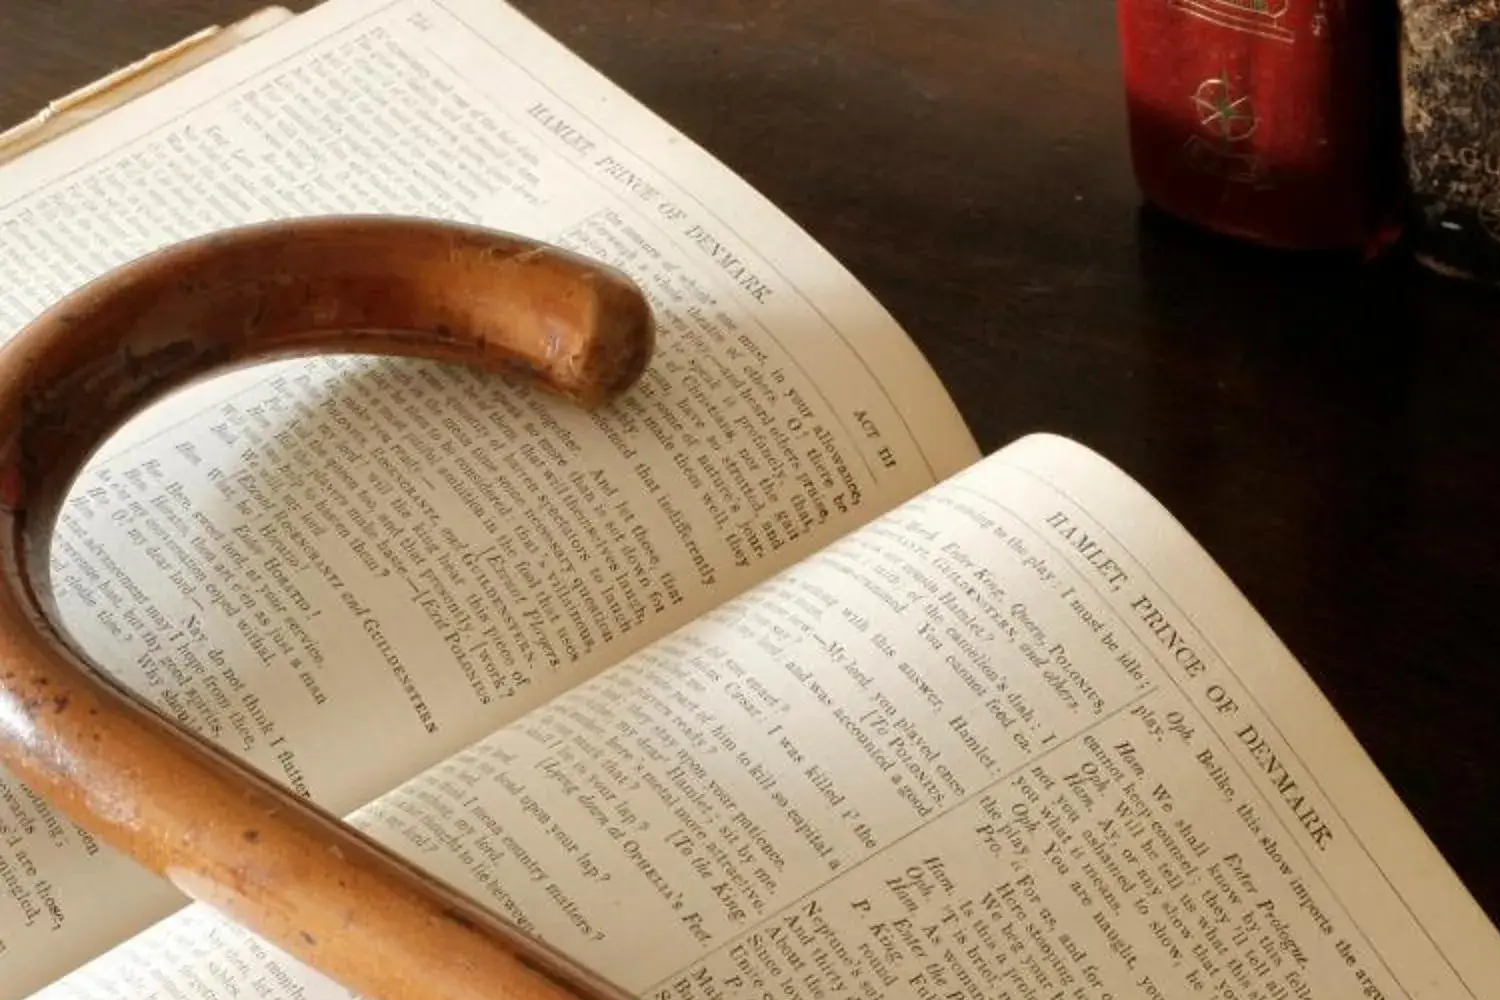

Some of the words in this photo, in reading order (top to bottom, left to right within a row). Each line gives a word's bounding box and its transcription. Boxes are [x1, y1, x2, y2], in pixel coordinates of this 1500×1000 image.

[594, 155, 659, 201] PRINCE
[684, 224, 773, 305] DENMARK.
[853, 410, 880, 438] ACT
[870, 633, 897, 657] this
[1045, 511, 1129, 592] HAMLET,
[1130, 594, 1206, 678] PRINCE
[1236, 723, 1333, 852] DENMARK.
[241, 693, 275, 736] think
[1131, 705, 1165, 743] play.
[1030, 766, 1056, 791] not
[1051, 793, 1081, 824] you
[1081, 829, 1137, 893] ashamed
[1083, 735, 1125, 783] cannot
[1121, 781, 1153, 826] keep
[1201, 889, 1231, 924] they
[1244, 949, 1271, 978] tell
[1113, 740, 1145, 781] Ham.
[1174, 819, 1211, 859] shall
[1206, 862, 1242, 904] know
[1259, 935, 1283, 967] this
[1115, 799, 1145, 839] Will
[1157, 862, 1184, 891] tell
[1197, 915, 1229, 956] what
[1227, 958, 1251, 990] this
[1235, 803, 1261, 835] this
[1259, 836, 1293, 875] show
[1289, 879, 1334, 935] imports
[1335, 939, 1357, 967] the
[1222, 852, 1258, 893] Enter
[1255, 898, 1309, 971] Prologue.
